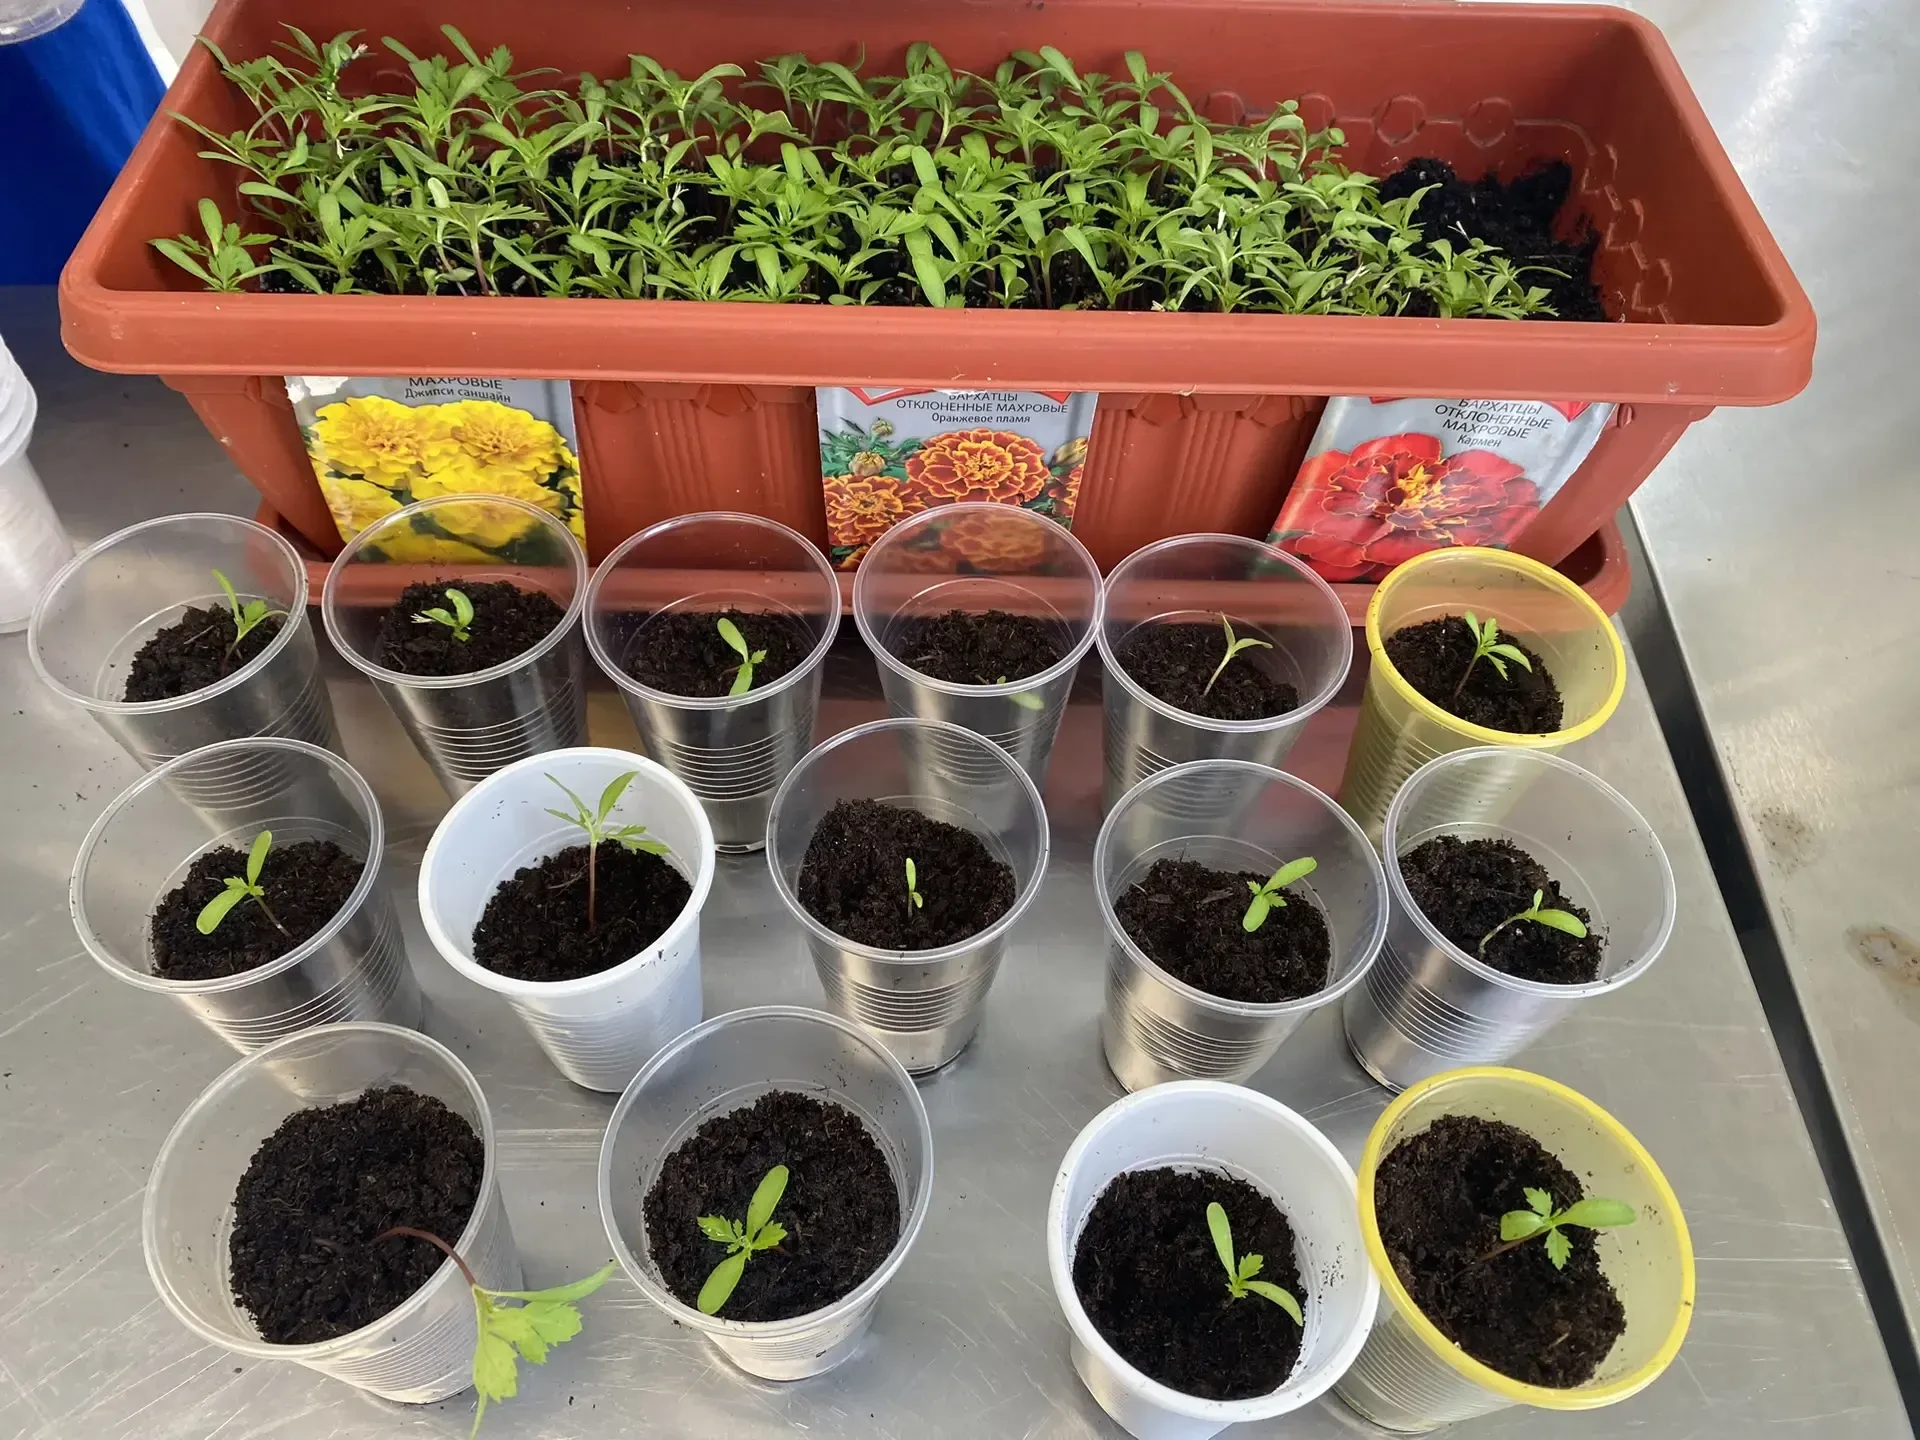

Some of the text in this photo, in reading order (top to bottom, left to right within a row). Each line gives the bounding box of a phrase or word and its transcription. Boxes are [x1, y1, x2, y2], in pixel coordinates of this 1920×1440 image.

[408, 377, 503, 390] МАХРОВЫЕ
[405, 388, 511, 403] Джипси саншайн
[896, 399, 1069, 413] ОТКЛОНЕННЫЕ МАХРОВЫЕ
[1458, 399, 1543, 415] БАРХАТЦЫ
[931, 412, 1031, 423] Оранжевое пламя
[1435, 404, 1554, 430] ОТКЛОНЕННЫЕ
[1442, 419, 1531, 439] МАХРОВЫЕ
[1457, 434, 1502, 447] Кармен
